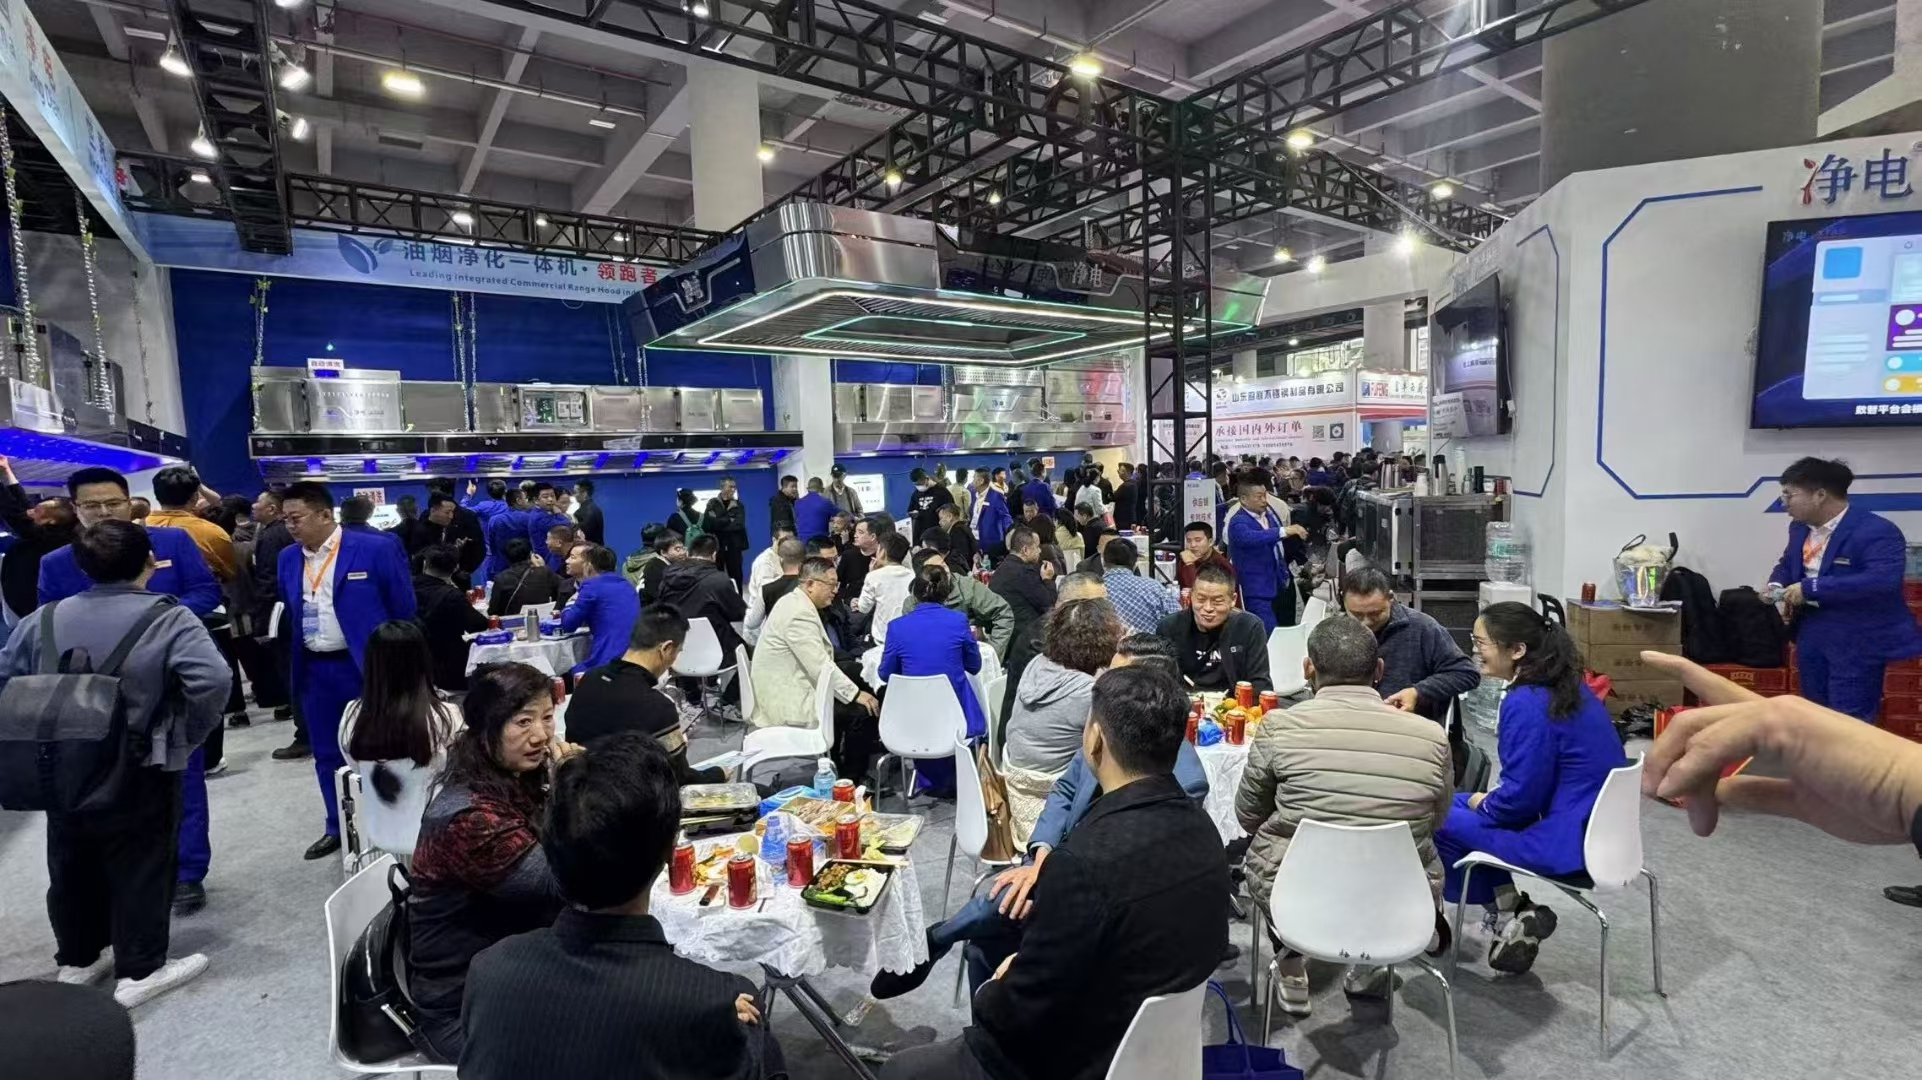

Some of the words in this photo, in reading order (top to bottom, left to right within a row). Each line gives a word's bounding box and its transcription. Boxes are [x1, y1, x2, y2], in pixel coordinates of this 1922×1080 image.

[1800, 148, 1914, 205] 净电
[409, 269, 452, 281] Leading
[510, 278, 566, 290] Commercial
[567, 283, 596, 294] Range
[597, 286, 621, 295] Hood
[1215, 420, 1302, 438] 承接国内外订单
